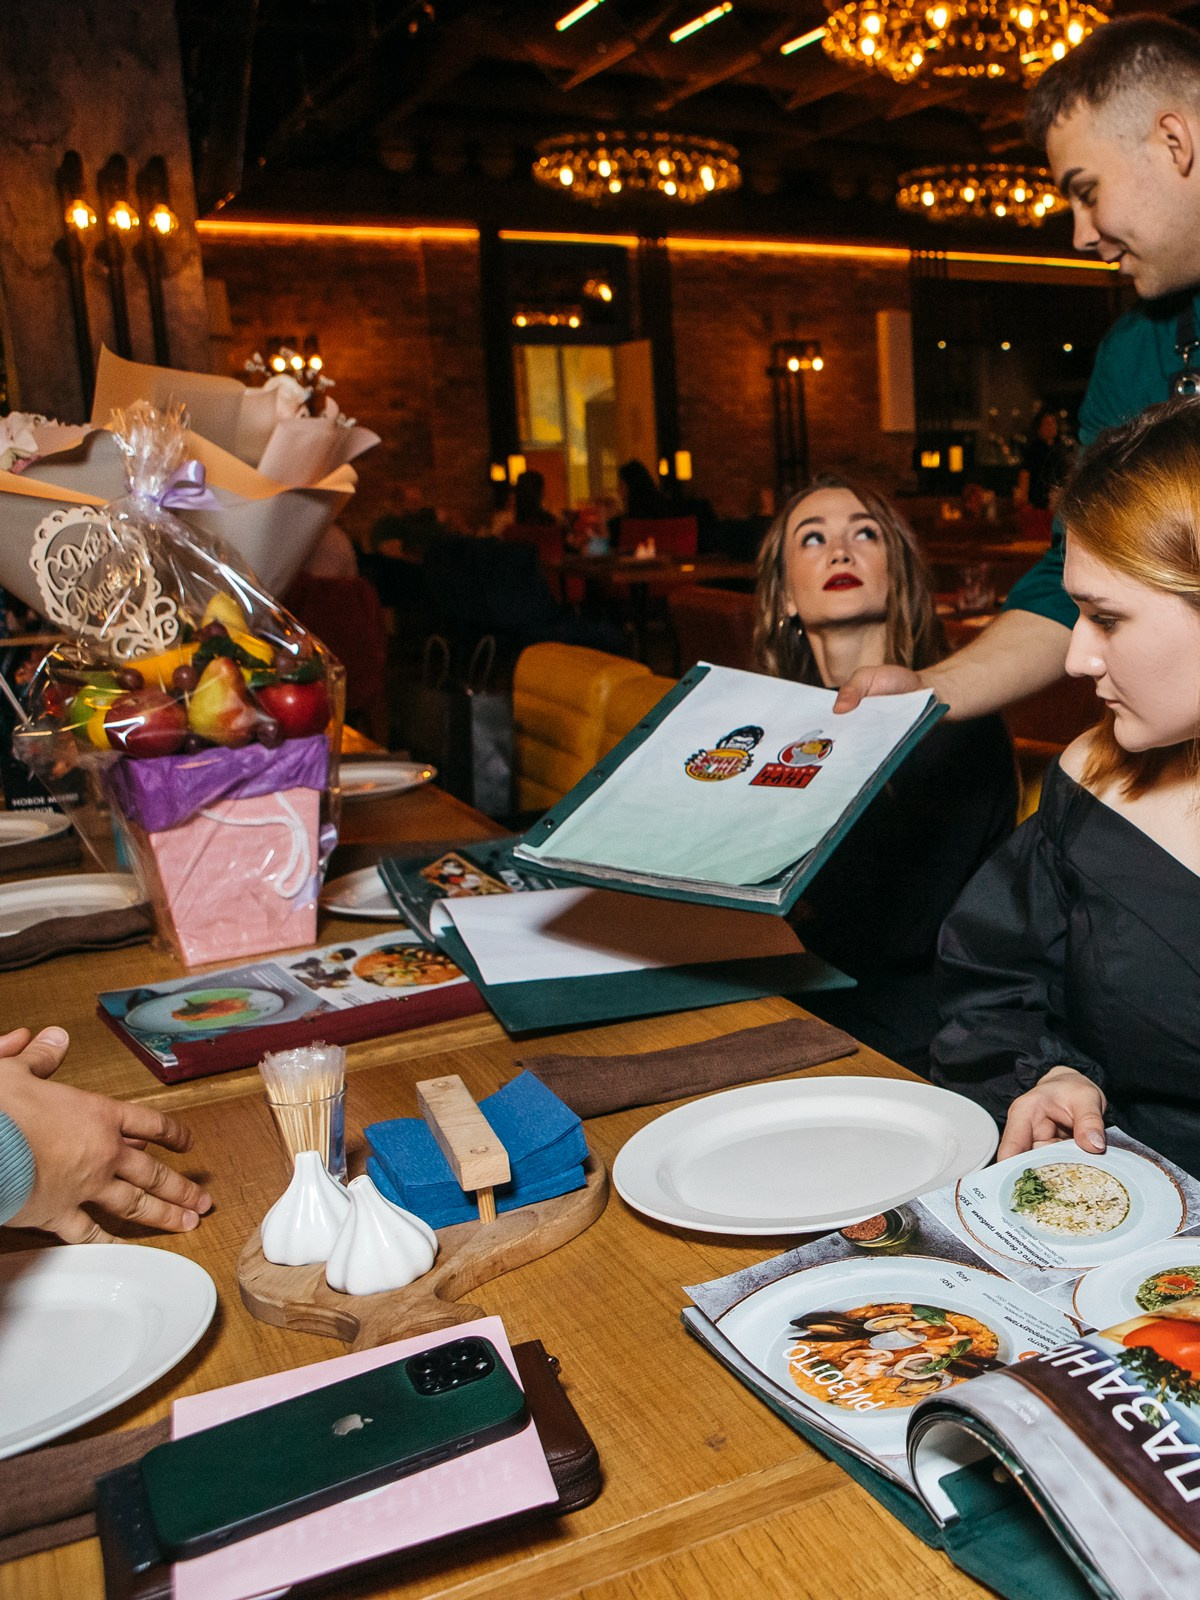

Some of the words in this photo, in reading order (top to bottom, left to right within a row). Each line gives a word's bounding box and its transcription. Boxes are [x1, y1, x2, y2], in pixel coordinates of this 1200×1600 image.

[971, 1209, 996, 1232] грибами
[995, 1230, 1018, 1251] белыми
[1005, 1230, 1050, 1265] шампиньонами
[782, 1345, 886, 1413] РИЗОТТО
